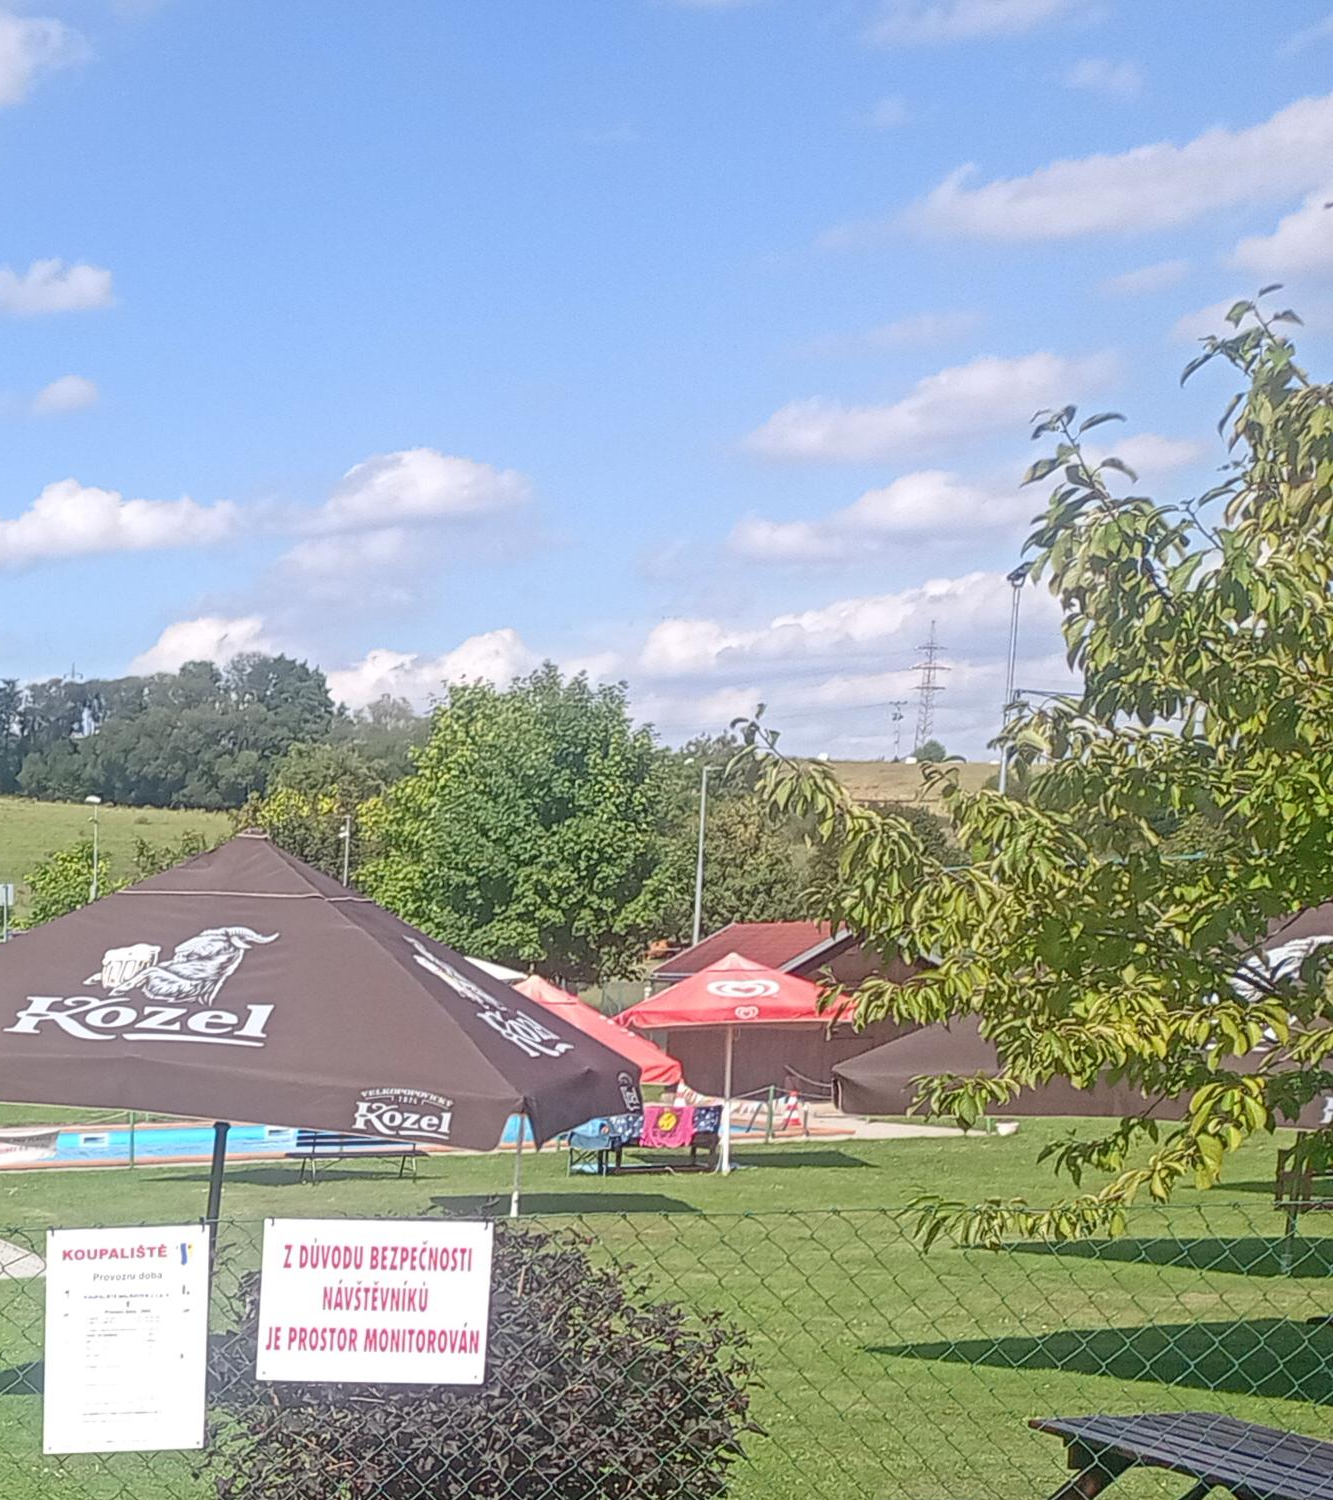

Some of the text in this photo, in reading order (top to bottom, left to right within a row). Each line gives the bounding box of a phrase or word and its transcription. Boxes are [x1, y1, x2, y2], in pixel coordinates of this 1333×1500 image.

[3, 996, 275, 1043] Kozel
[352, 1101, 452, 1137] Kozel
[62, 1243, 168, 1261] KOUPALIŠTĚ
[283, 1238, 473, 1272] Z DŮVODU BEZPEČNOSTI
[138, 1271, 163, 1280] doba
[322, 1279, 429, 1312] NÁVŠTĚVNÍKŮ
[266, 1322, 480, 1354] JE PROSTOR MONITOROVÁN
